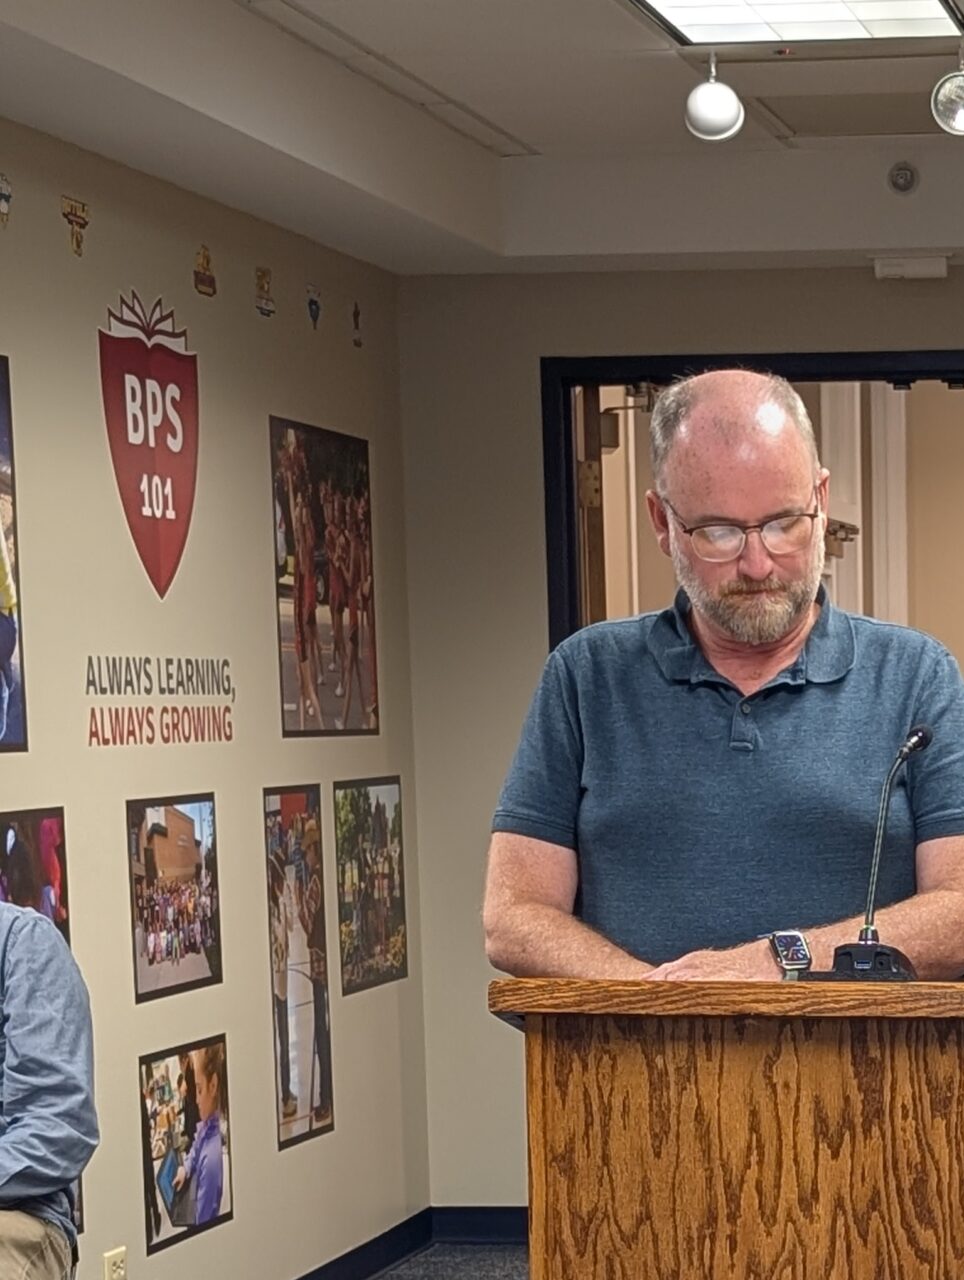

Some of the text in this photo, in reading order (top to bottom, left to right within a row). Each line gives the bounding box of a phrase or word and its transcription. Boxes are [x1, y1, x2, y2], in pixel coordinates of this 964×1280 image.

[124, 373, 184, 453] BPS
[140, 473, 177, 520] 101
[85, 655, 236, 703] ALWAYS LEARNING,
[88, 705, 233, 747] ALWAYS GROWING
